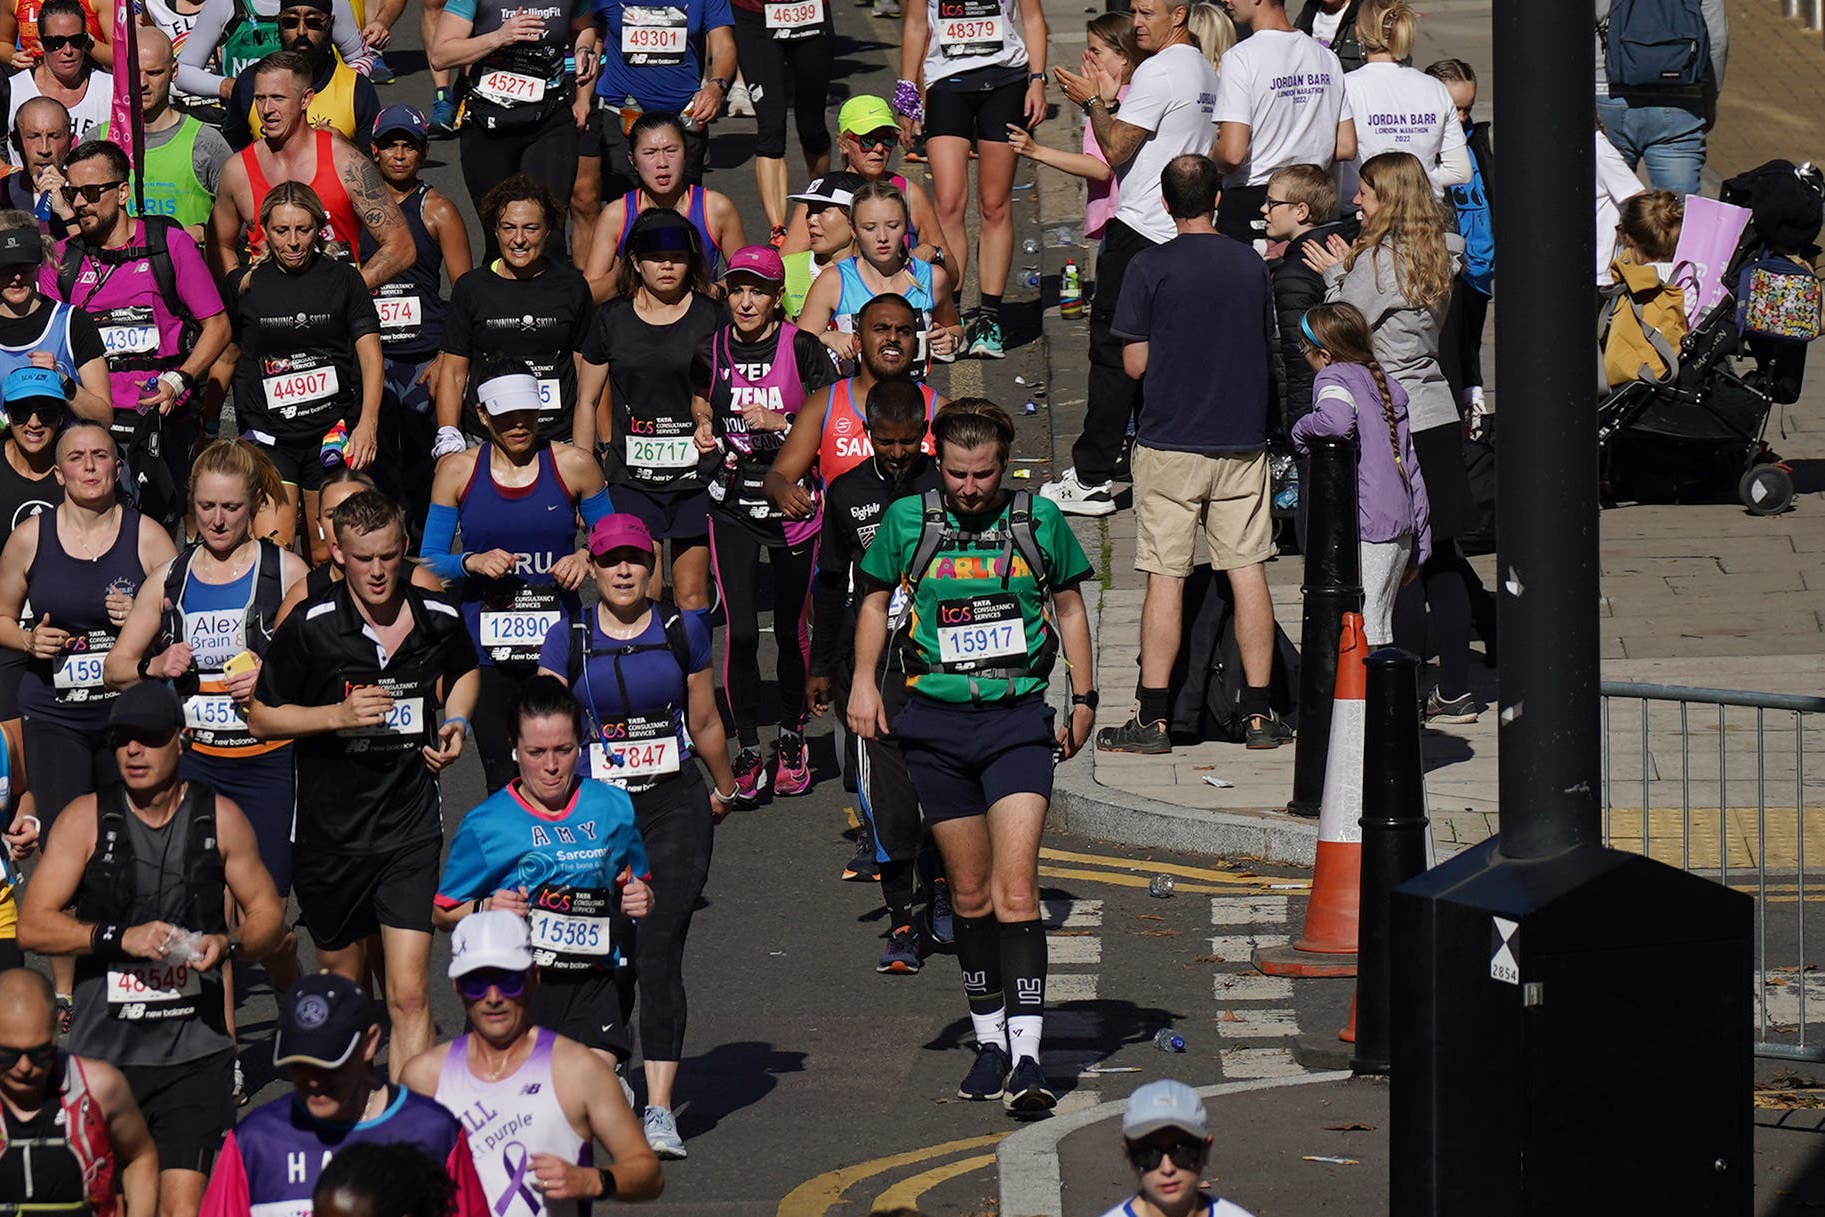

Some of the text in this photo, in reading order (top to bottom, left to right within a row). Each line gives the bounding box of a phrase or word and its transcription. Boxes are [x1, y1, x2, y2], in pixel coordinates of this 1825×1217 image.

[774, 4, 816, 23] 46399
[941, 2, 964, 17] tcs
[629, 30, 677, 47] 49301
[947, 21, 994, 39] 48379
[488, 73, 535, 97] 45271
[1269, 73, 1331, 90] JORDAN BARR
[1367, 113, 1437, 126] JORDAN BARR
[1375, 126, 1429, 135] LONDON MARATHON
[274, 373, 327, 400] 44907
[730, 386, 784, 412] ZENA
[631, 416, 654, 434] tcs
[634, 442, 689, 461] 26717
[942, 604, 972, 624] tcs
[974, 603, 1015, 614] CONSULTANCY
[974, 611, 1001, 621] SERVICES
[193, 616, 243, 635] Alex
[491, 616, 550, 638] 12890
[190, 635, 231, 650] Brain
[950, 626, 1012, 654] 15917
[532, 820, 597, 847] AMY
[538, 888, 572, 911] tcs
[538, 917, 600, 947] 15585
[118, 964, 188, 993] 48549
[1491, 964, 1517, 982] 2854
[145, 1006, 195, 1019] new balance
[484, 1112, 534, 1150] purple
